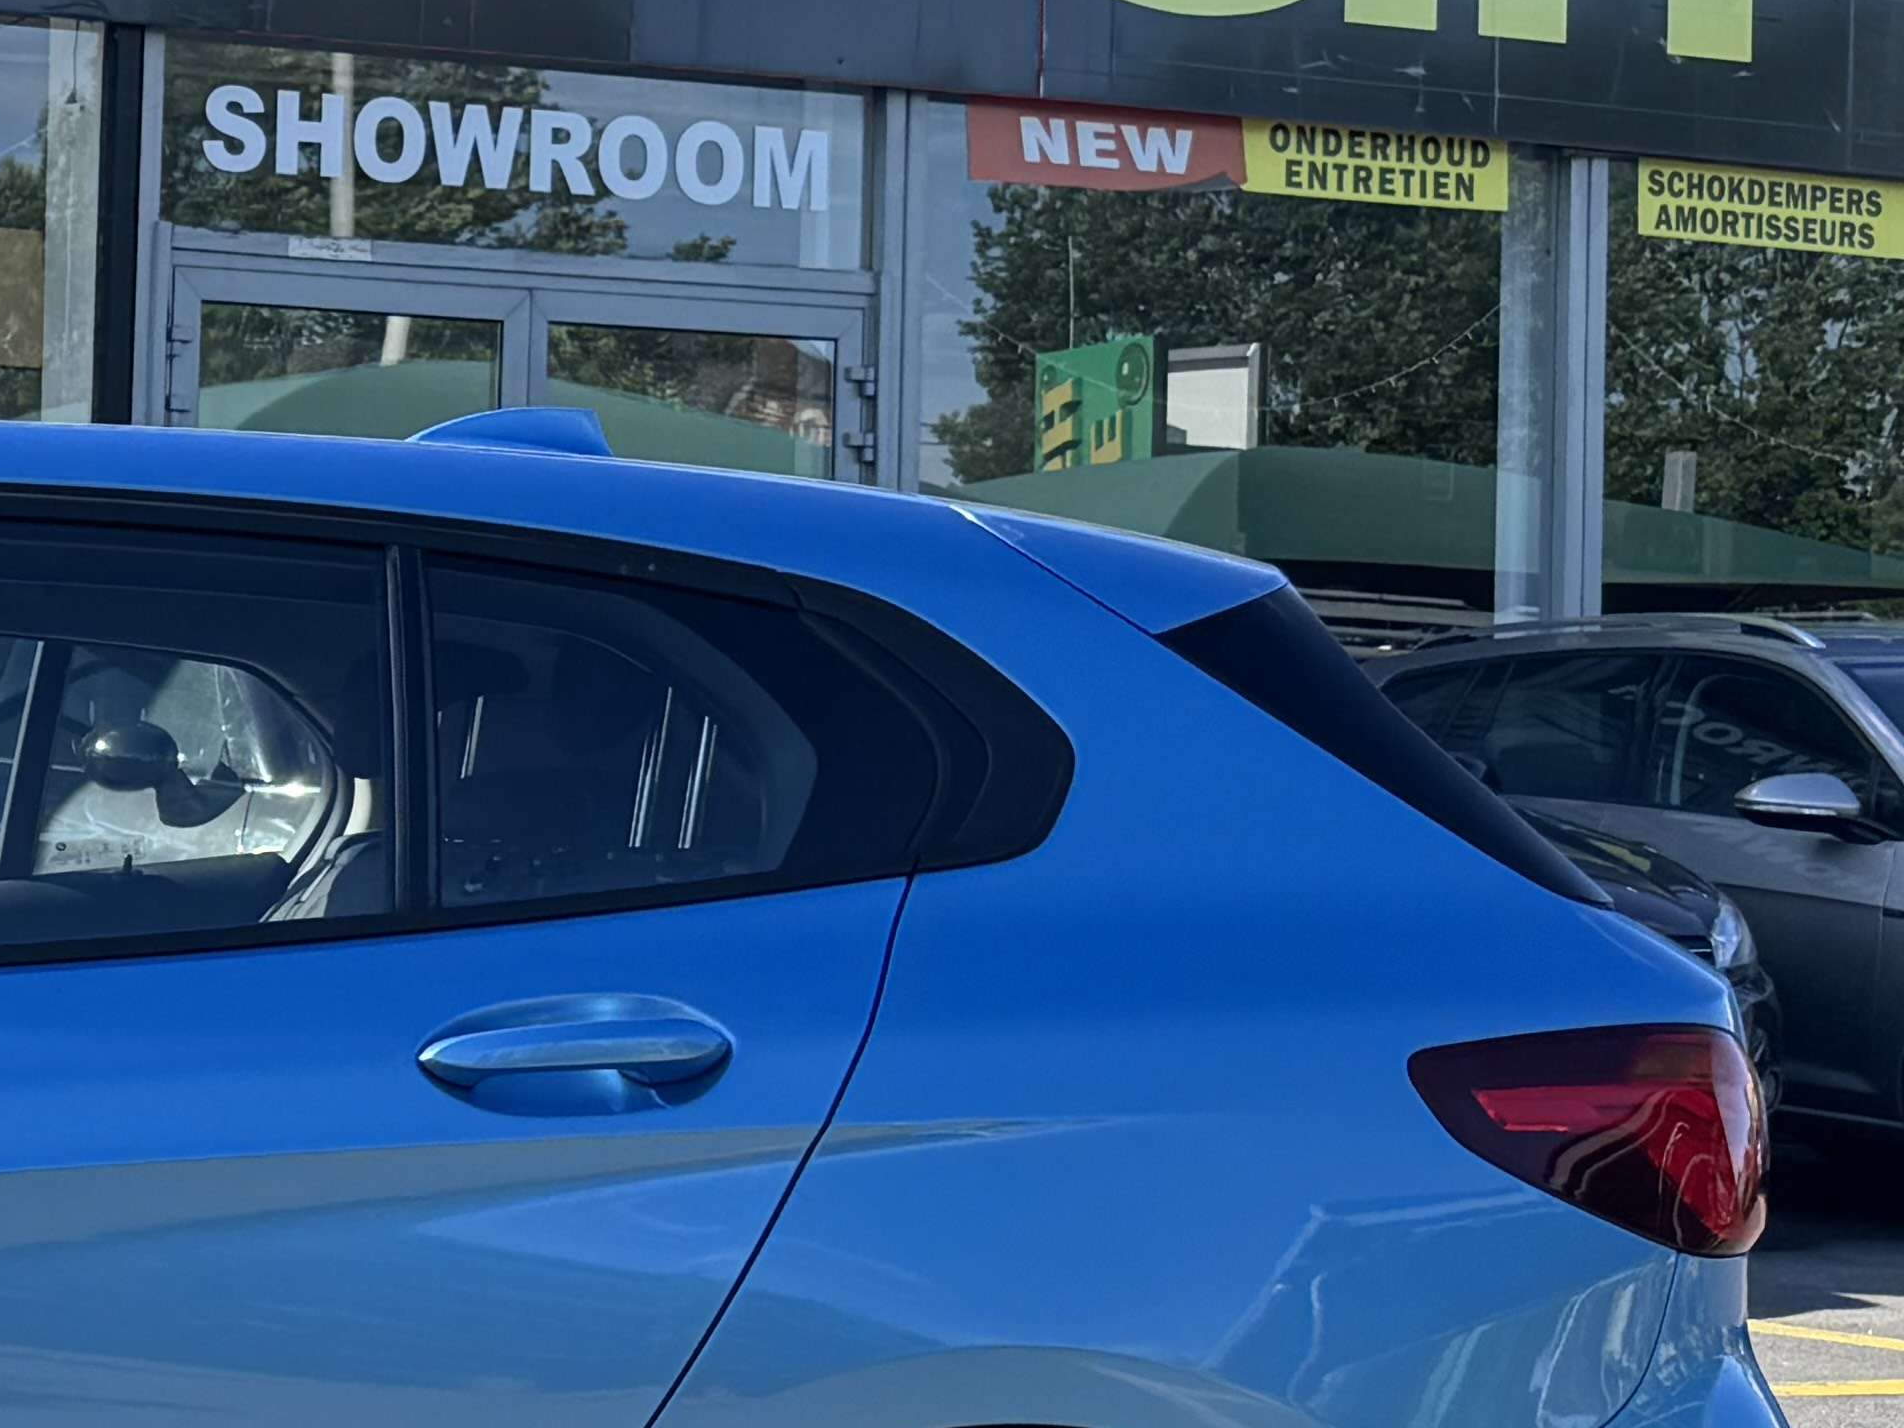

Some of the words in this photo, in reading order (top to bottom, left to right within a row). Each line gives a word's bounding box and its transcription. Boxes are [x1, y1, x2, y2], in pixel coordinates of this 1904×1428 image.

[201, 84, 829, 212] SHOWROOM
[1018, 115, 1193, 175] NEW
[1268, 122, 1492, 169] ONDERHOUD
[1284, 158, 1477, 203] ENTRETIEN
[1647, 168, 1883, 218] SCHOKDEMPERS
[1653, 203, 1876, 250] AMORTISSEURS
